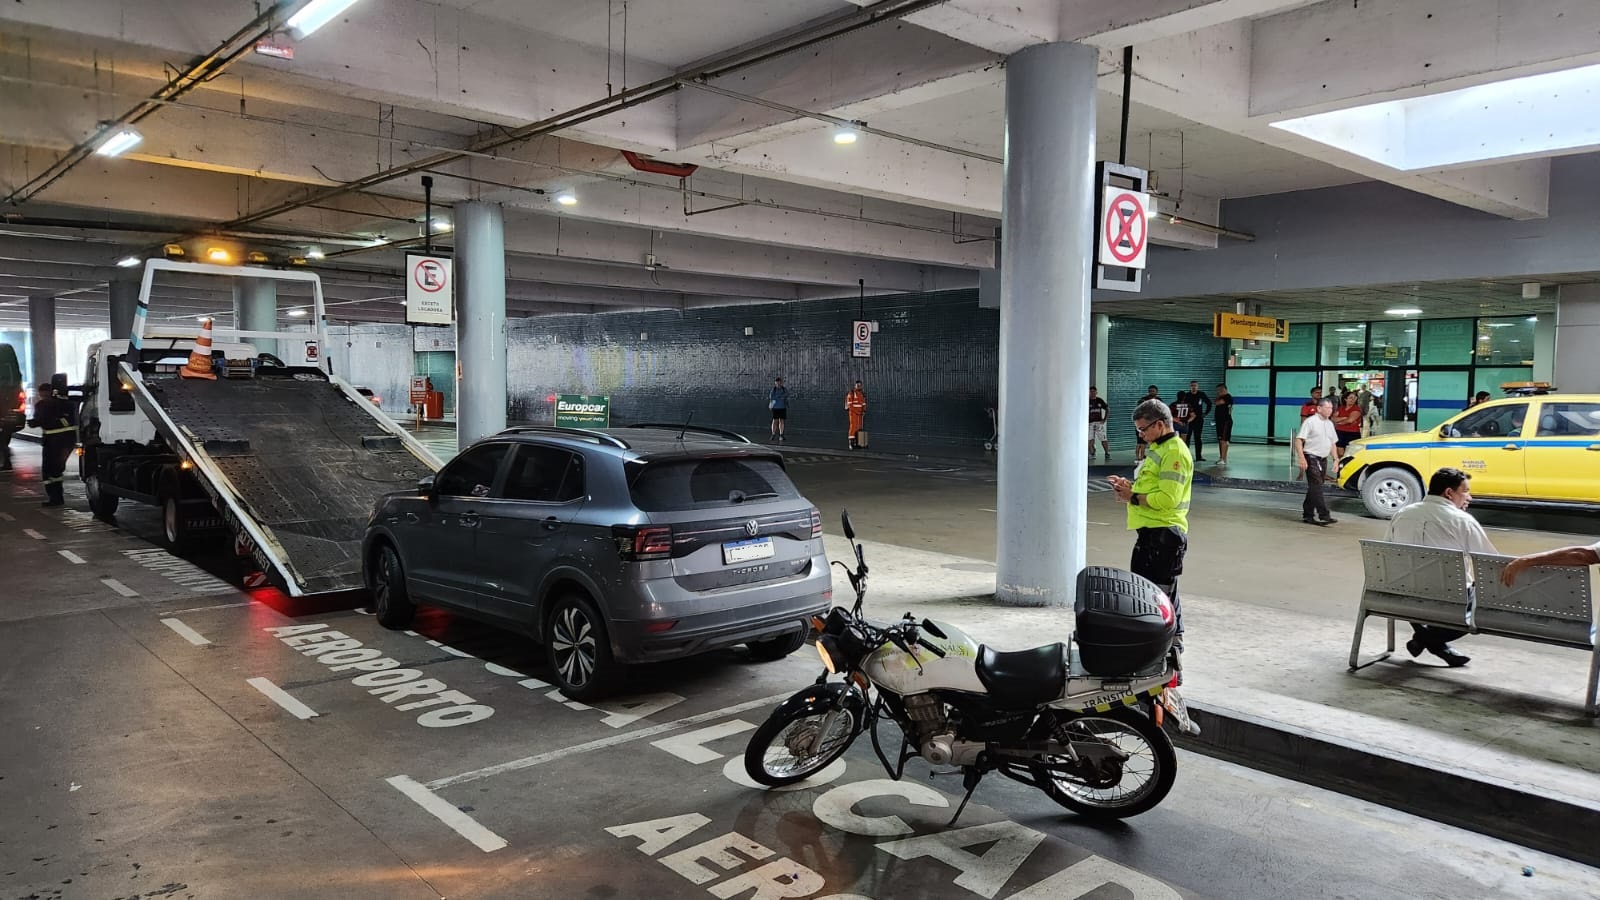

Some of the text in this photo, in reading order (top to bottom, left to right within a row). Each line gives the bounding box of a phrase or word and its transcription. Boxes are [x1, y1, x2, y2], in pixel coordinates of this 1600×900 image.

[557, 401, 606, 413] Europcar
[1176, 407, 1189, 418] 10
[263, 623, 495, 728] AEROPORTO
[1083, 689, 1134, 708] TRÂNSITO
[603, 812, 871, 900] AER
